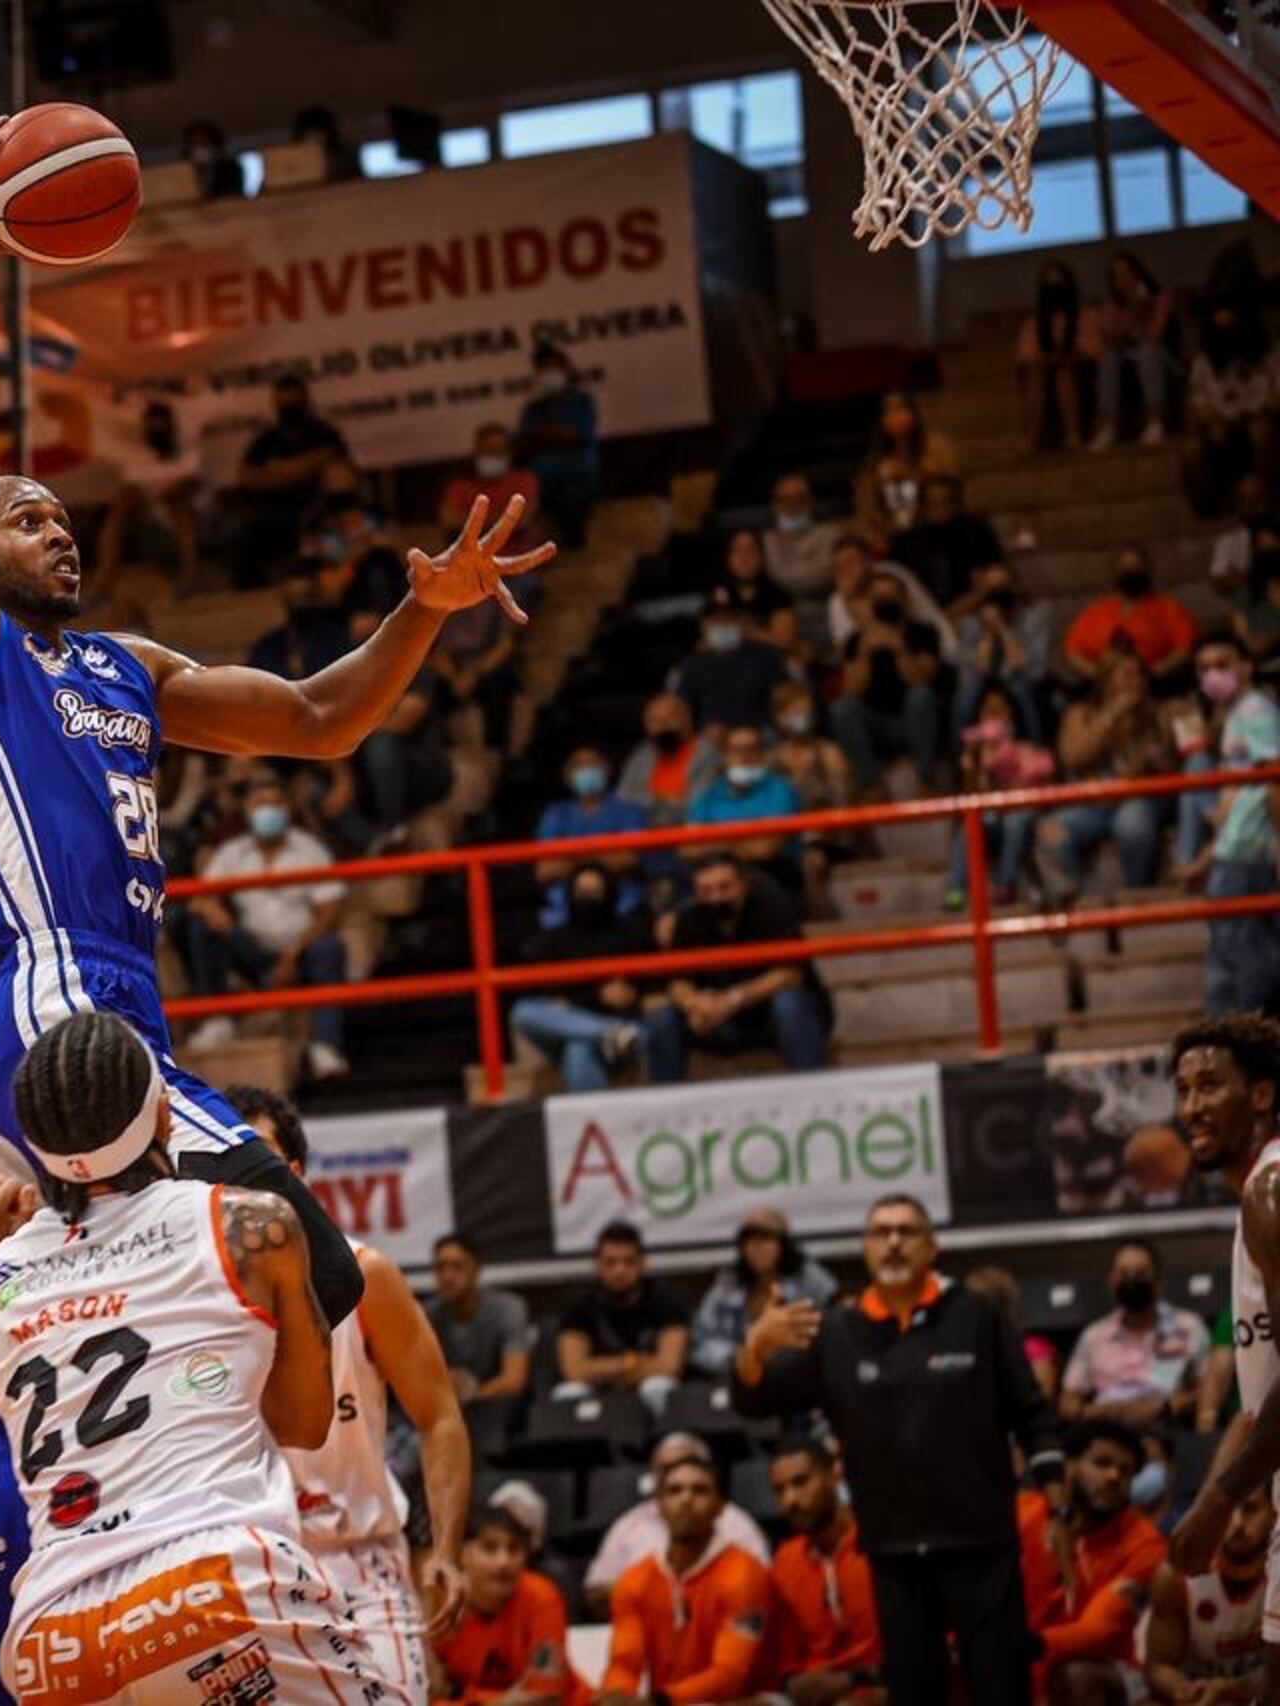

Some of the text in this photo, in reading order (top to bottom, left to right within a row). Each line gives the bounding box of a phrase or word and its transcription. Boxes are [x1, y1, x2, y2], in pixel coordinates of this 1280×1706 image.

[125, 208, 666, 344] BIENVENIDOS
[369, 325, 519, 374] OLIVERA
[561, 1096, 934, 1217] Agranel
[9, 1294, 128, 1342] MASON
[6, 1326, 151, 1485] 22
